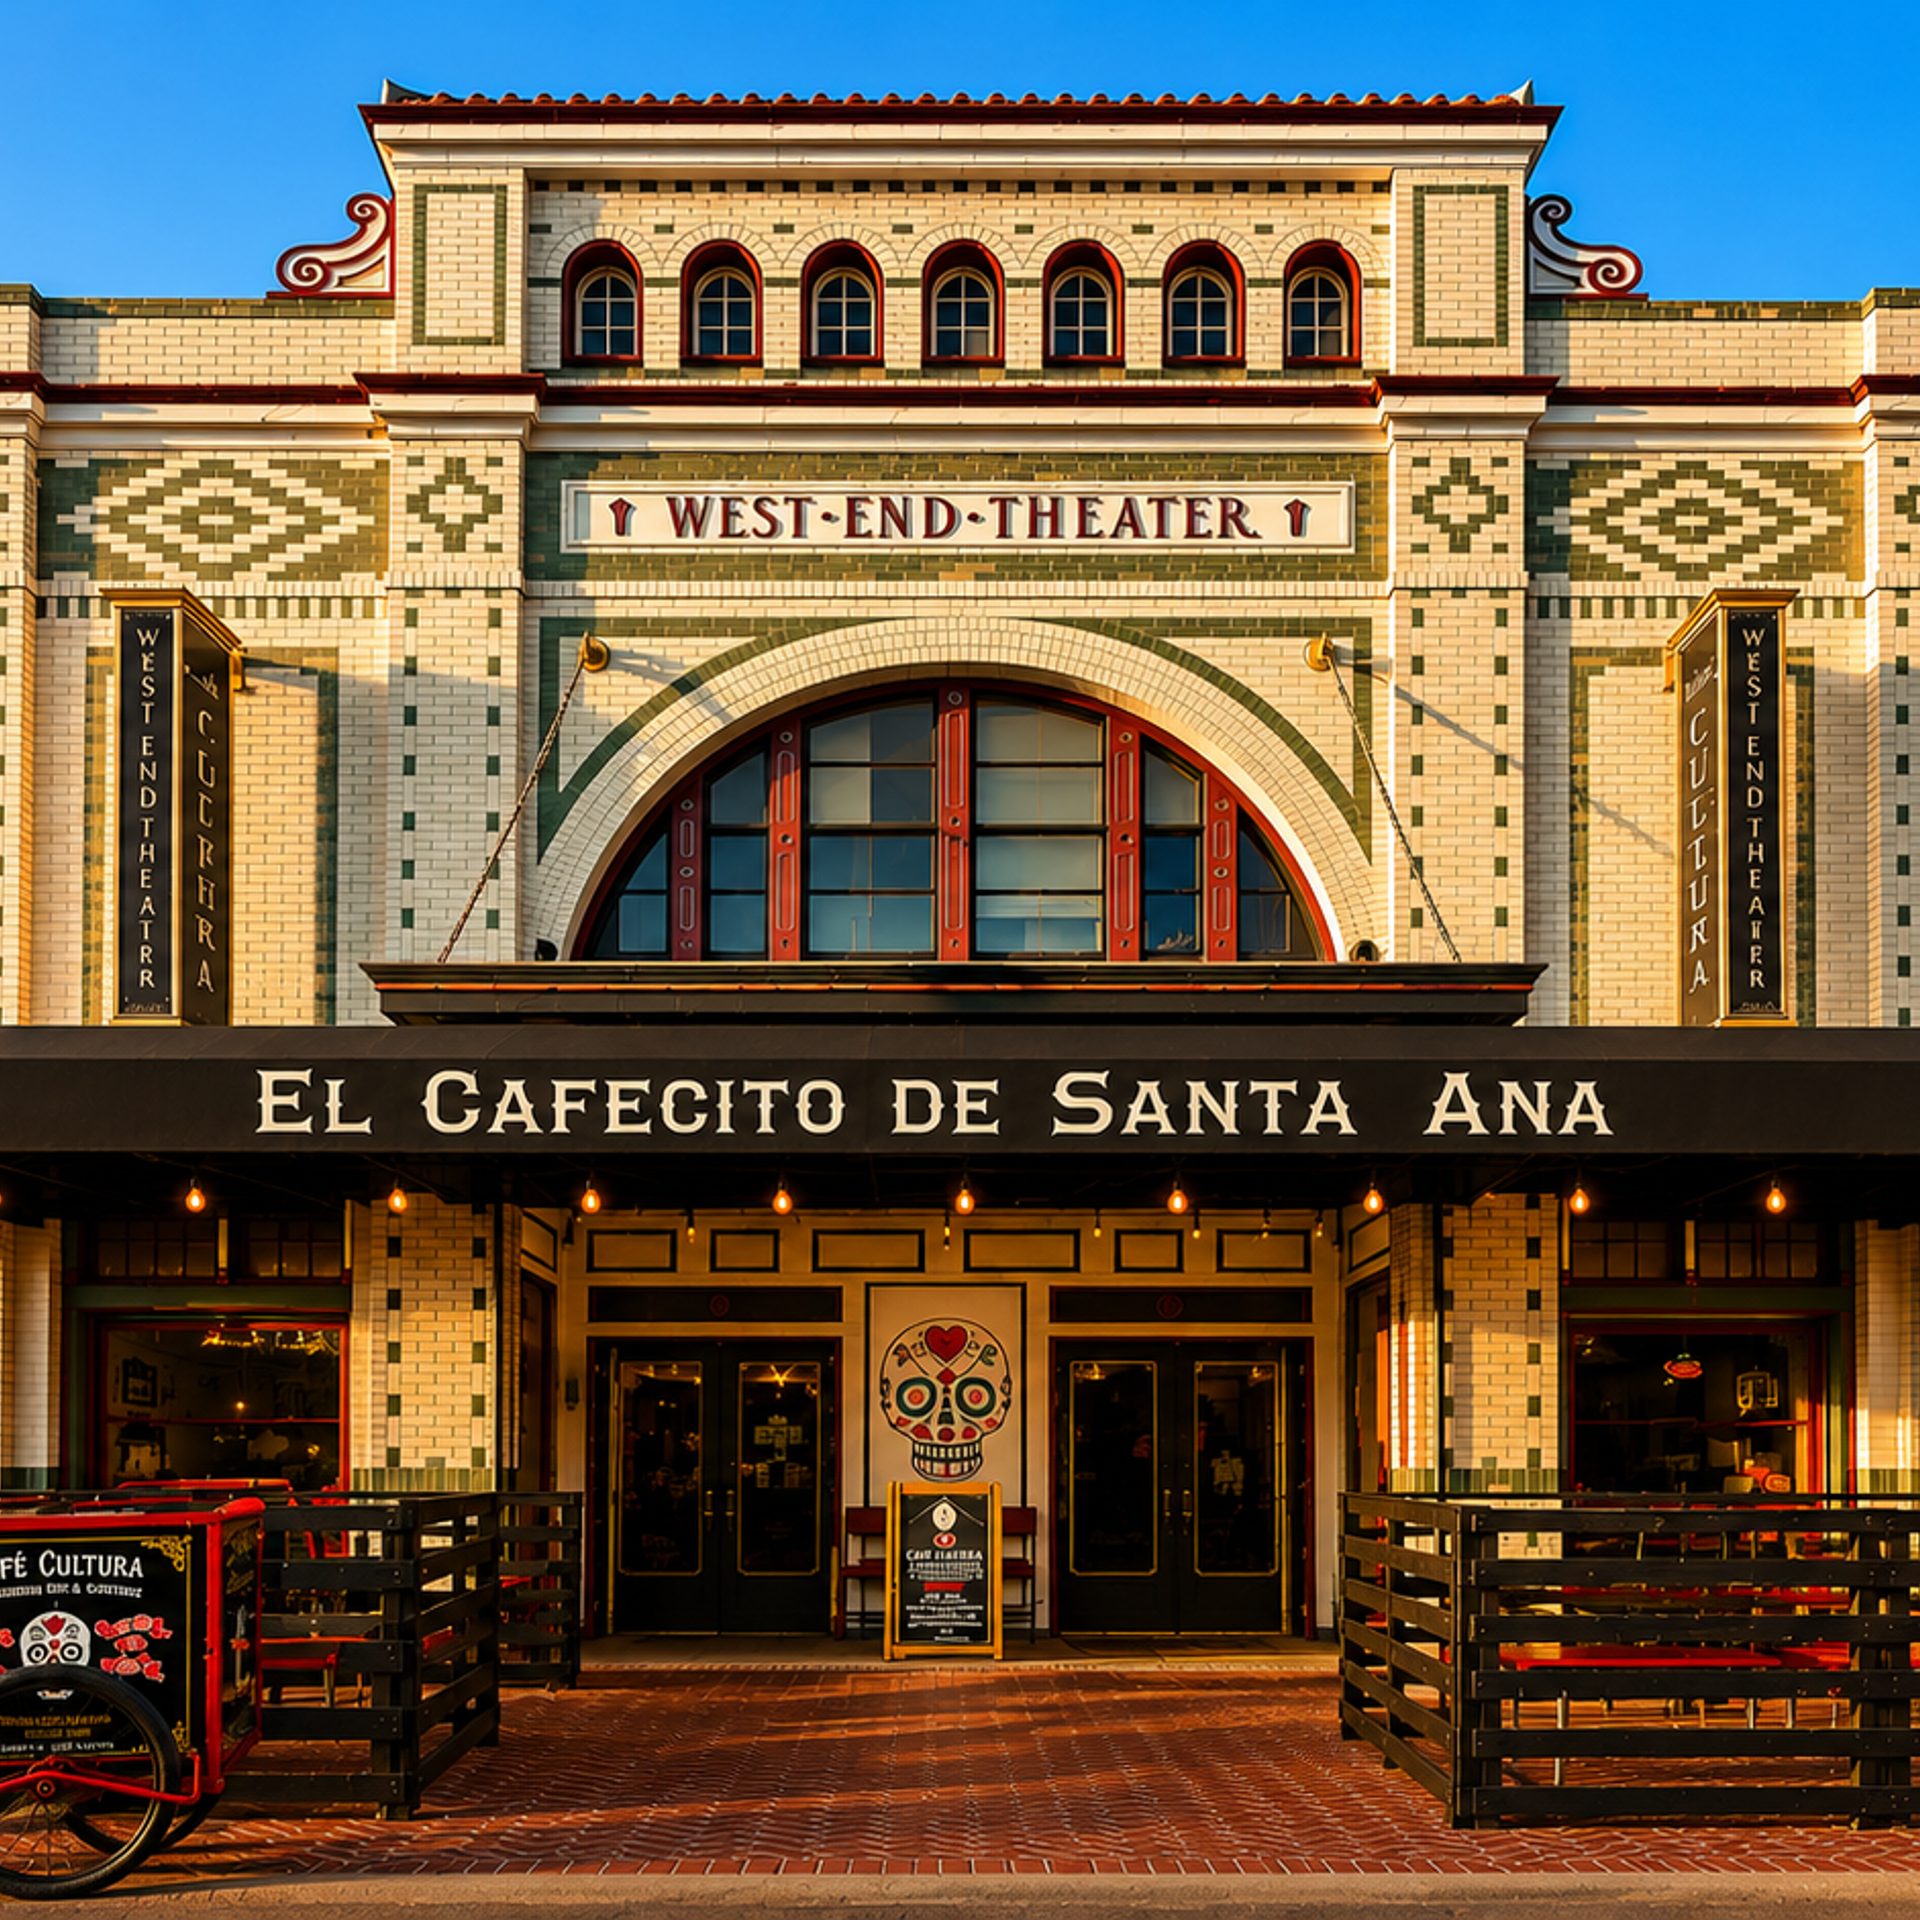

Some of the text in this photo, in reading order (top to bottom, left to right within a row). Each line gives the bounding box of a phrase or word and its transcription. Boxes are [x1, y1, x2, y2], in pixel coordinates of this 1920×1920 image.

[991, 496, 1262, 542] THEATER
[136, 628, 160, 725] WEST
[1742, 628, 1765, 725] WEST
[139, 735, 157, 809] END
[1746, 735, 1764, 809] END
[255, 1068, 1614, 1136] EL CAFECITO DE SANTA ANA
[38, 1549, 145, 1579] CULTURA
